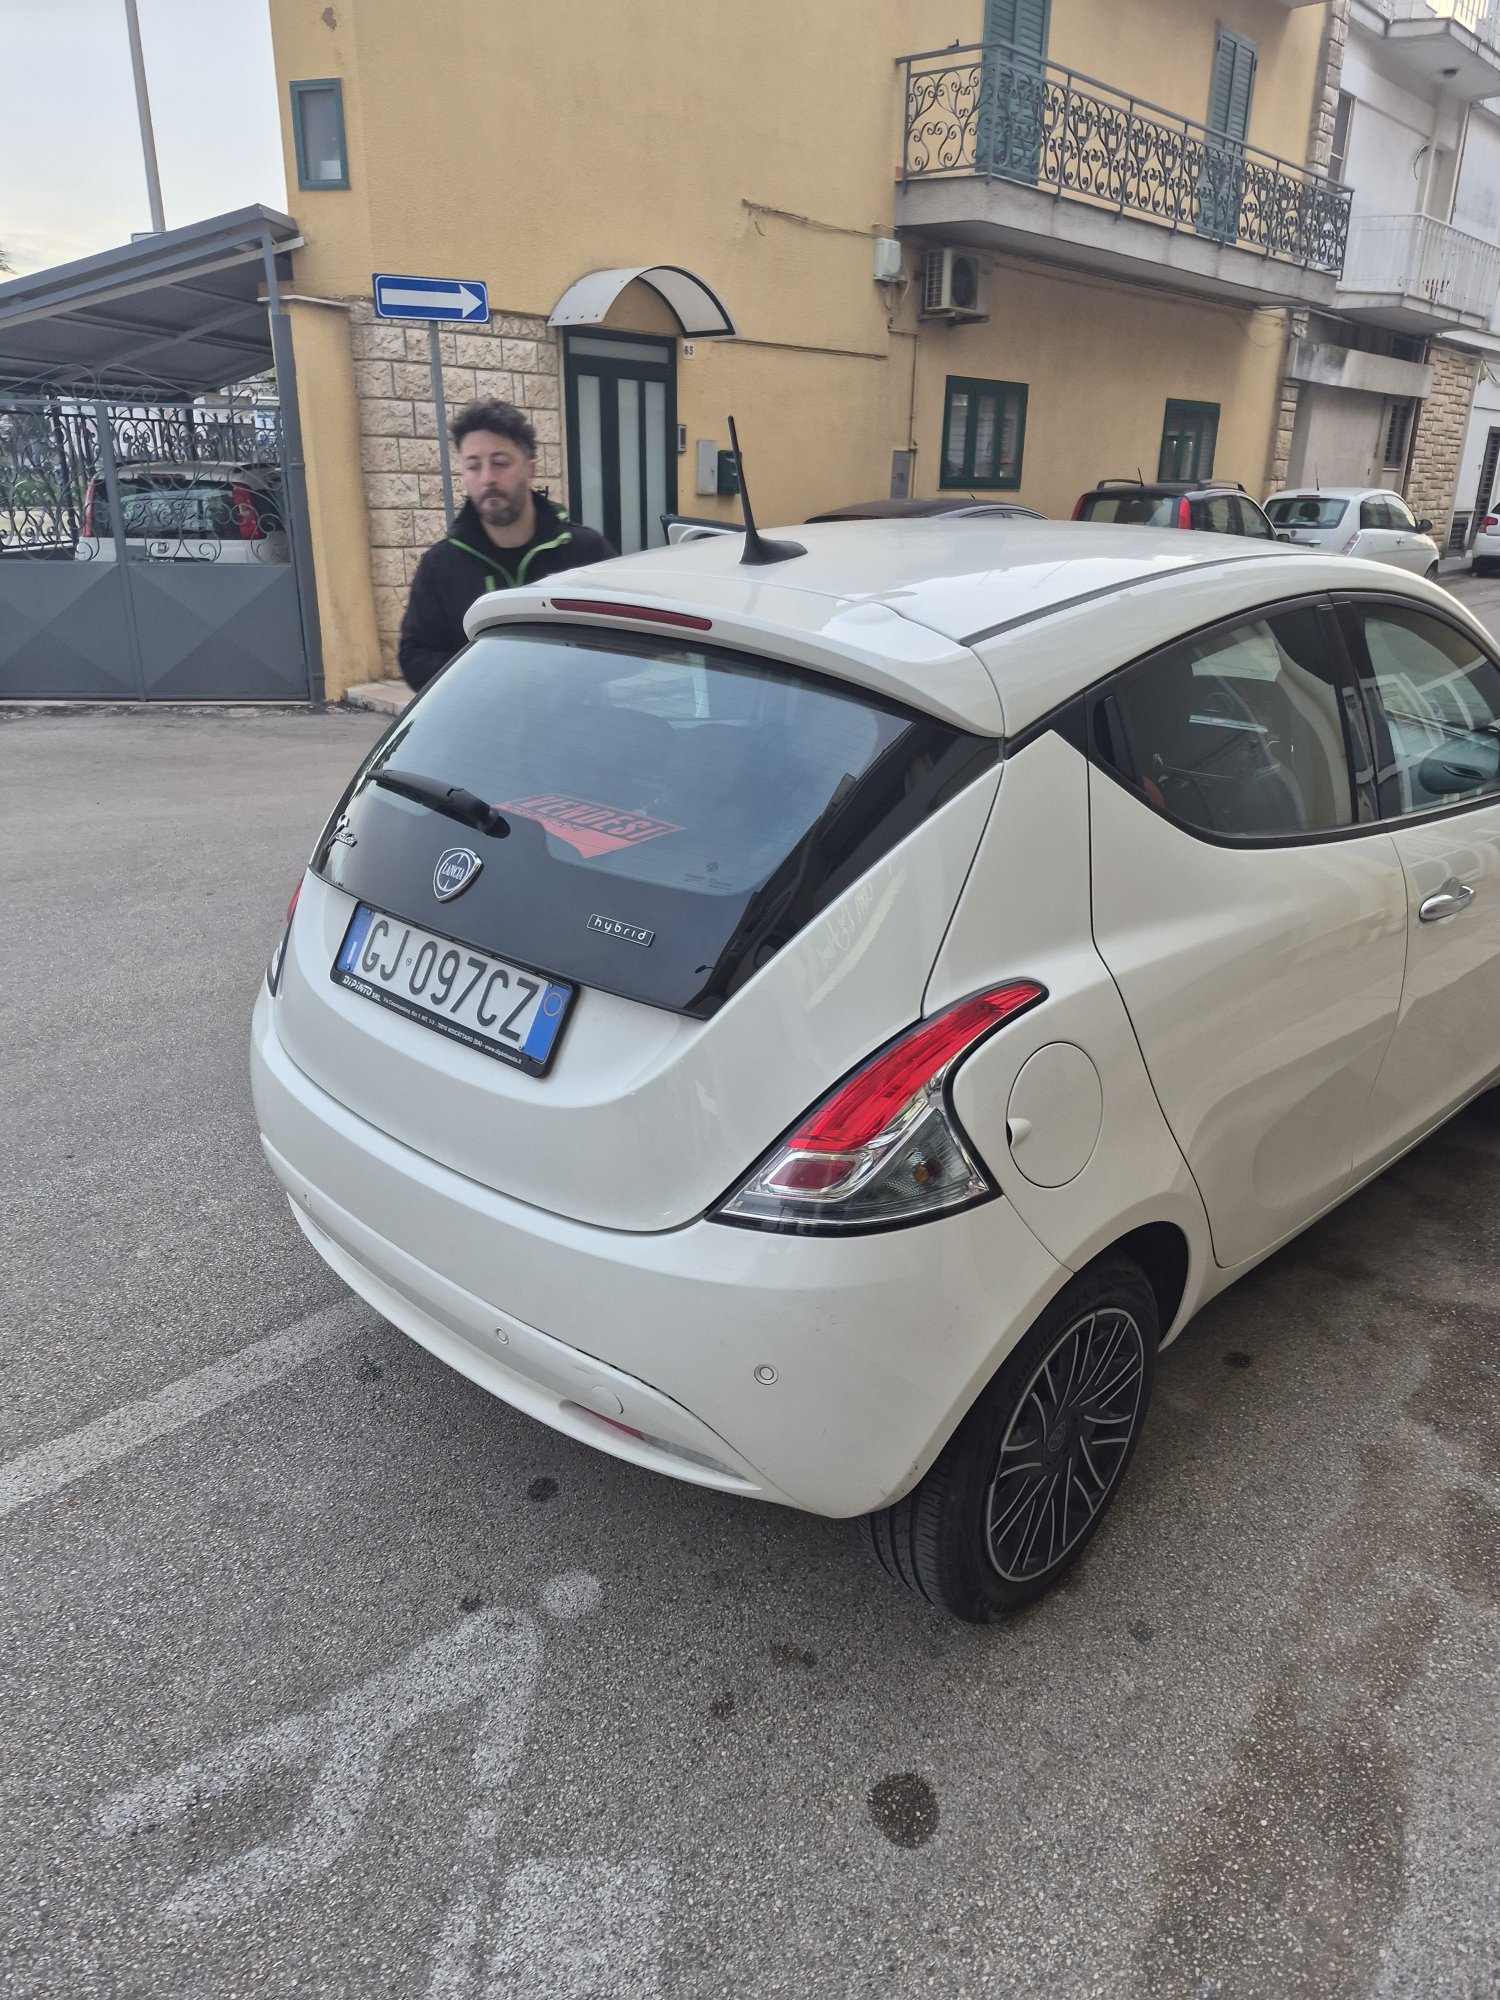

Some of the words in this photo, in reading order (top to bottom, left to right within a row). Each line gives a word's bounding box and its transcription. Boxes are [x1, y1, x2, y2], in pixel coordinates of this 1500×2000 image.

[519, 796, 666, 840] VENDESI
[441, 863, 465, 881] LANCIA
[594, 917, 647, 940] hybrid
